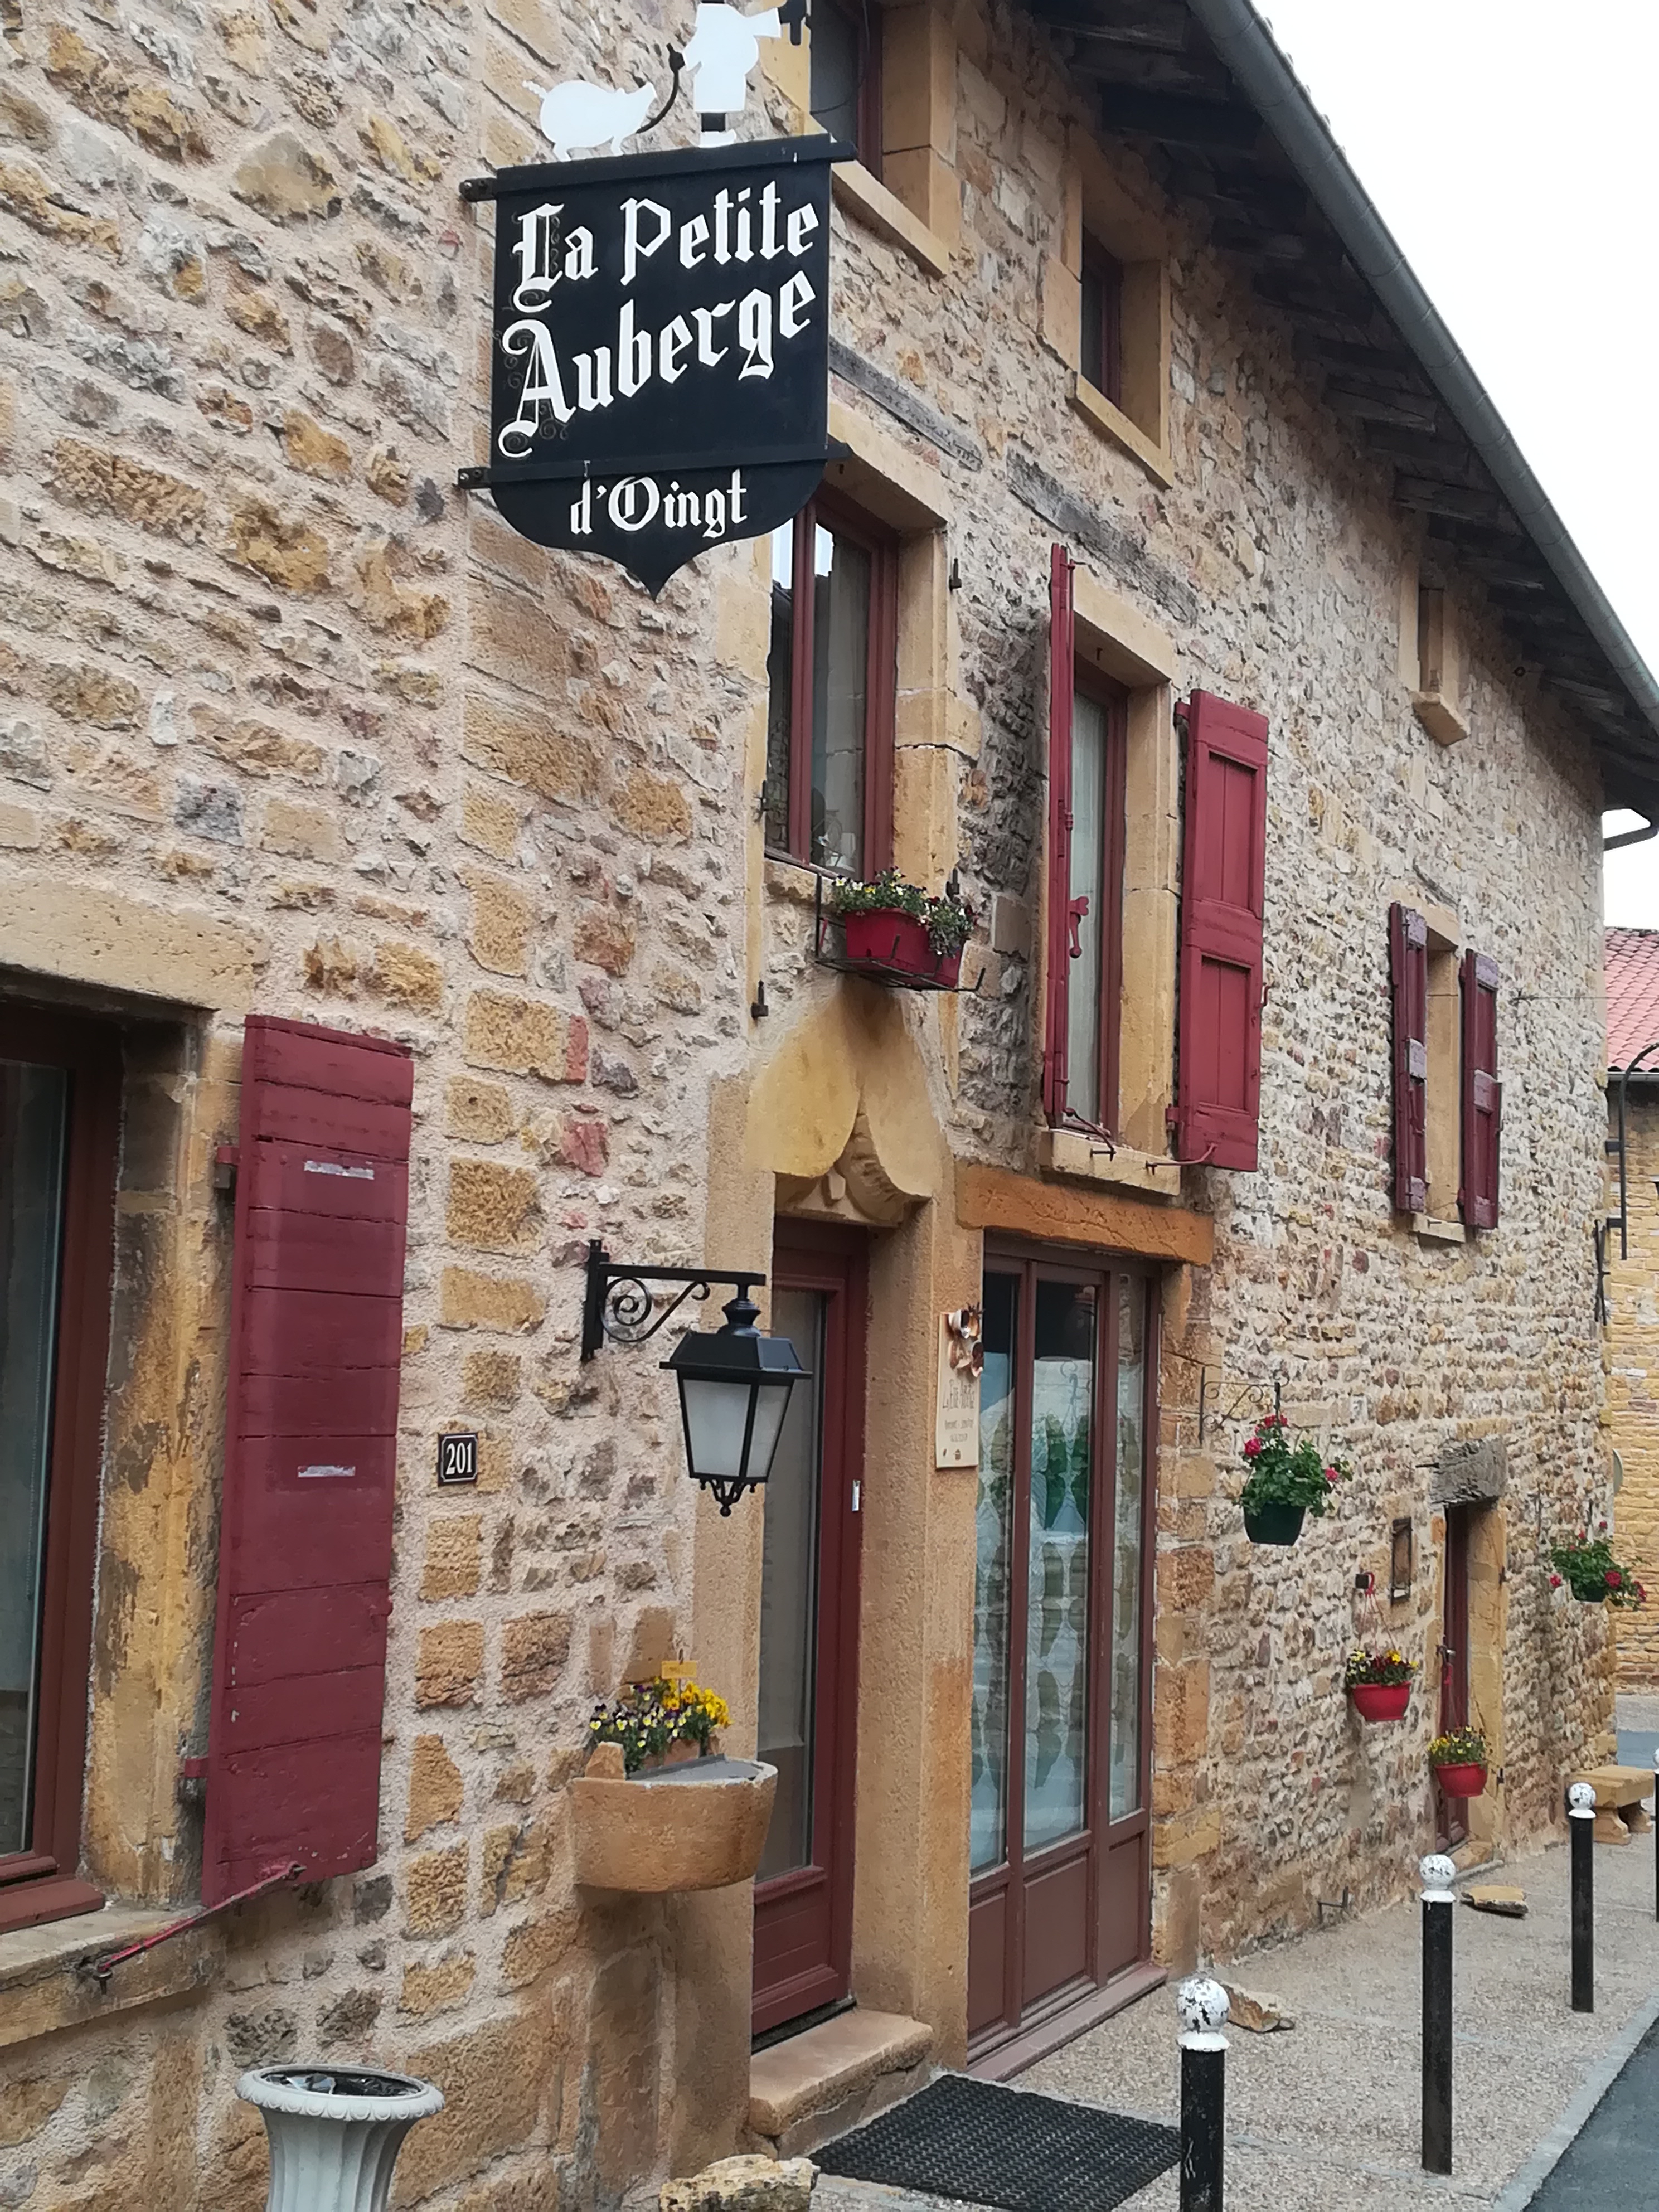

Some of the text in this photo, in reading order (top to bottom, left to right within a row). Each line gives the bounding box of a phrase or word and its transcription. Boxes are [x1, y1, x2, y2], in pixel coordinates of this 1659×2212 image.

[511, 180, 819, 313] La Petite
[497, 270, 817, 458] Auberge
[570, 469, 748, 539] d'Oingt
[445, 1442, 473, 1475] 201
